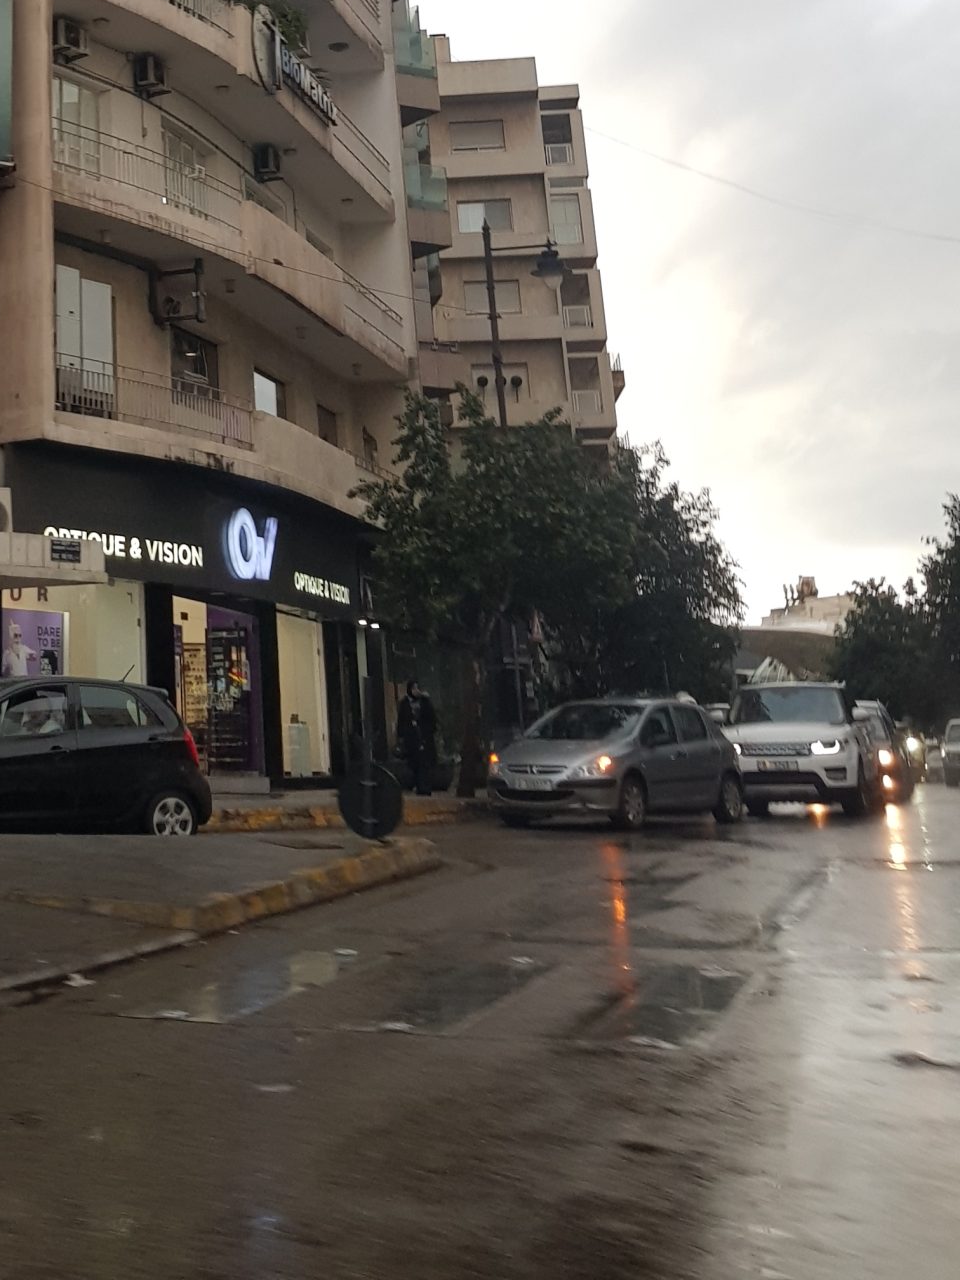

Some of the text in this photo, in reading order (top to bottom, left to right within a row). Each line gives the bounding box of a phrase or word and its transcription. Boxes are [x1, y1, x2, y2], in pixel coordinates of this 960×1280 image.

[129, 537, 142, 559] &
[145, 539, 204, 568] VISION
[294, 571, 324, 598] OPTIQUE
[329, 581, 350, 605] VISION
[37, 625, 61, 638] DARE
[37, 637, 61, 648] TO BE
